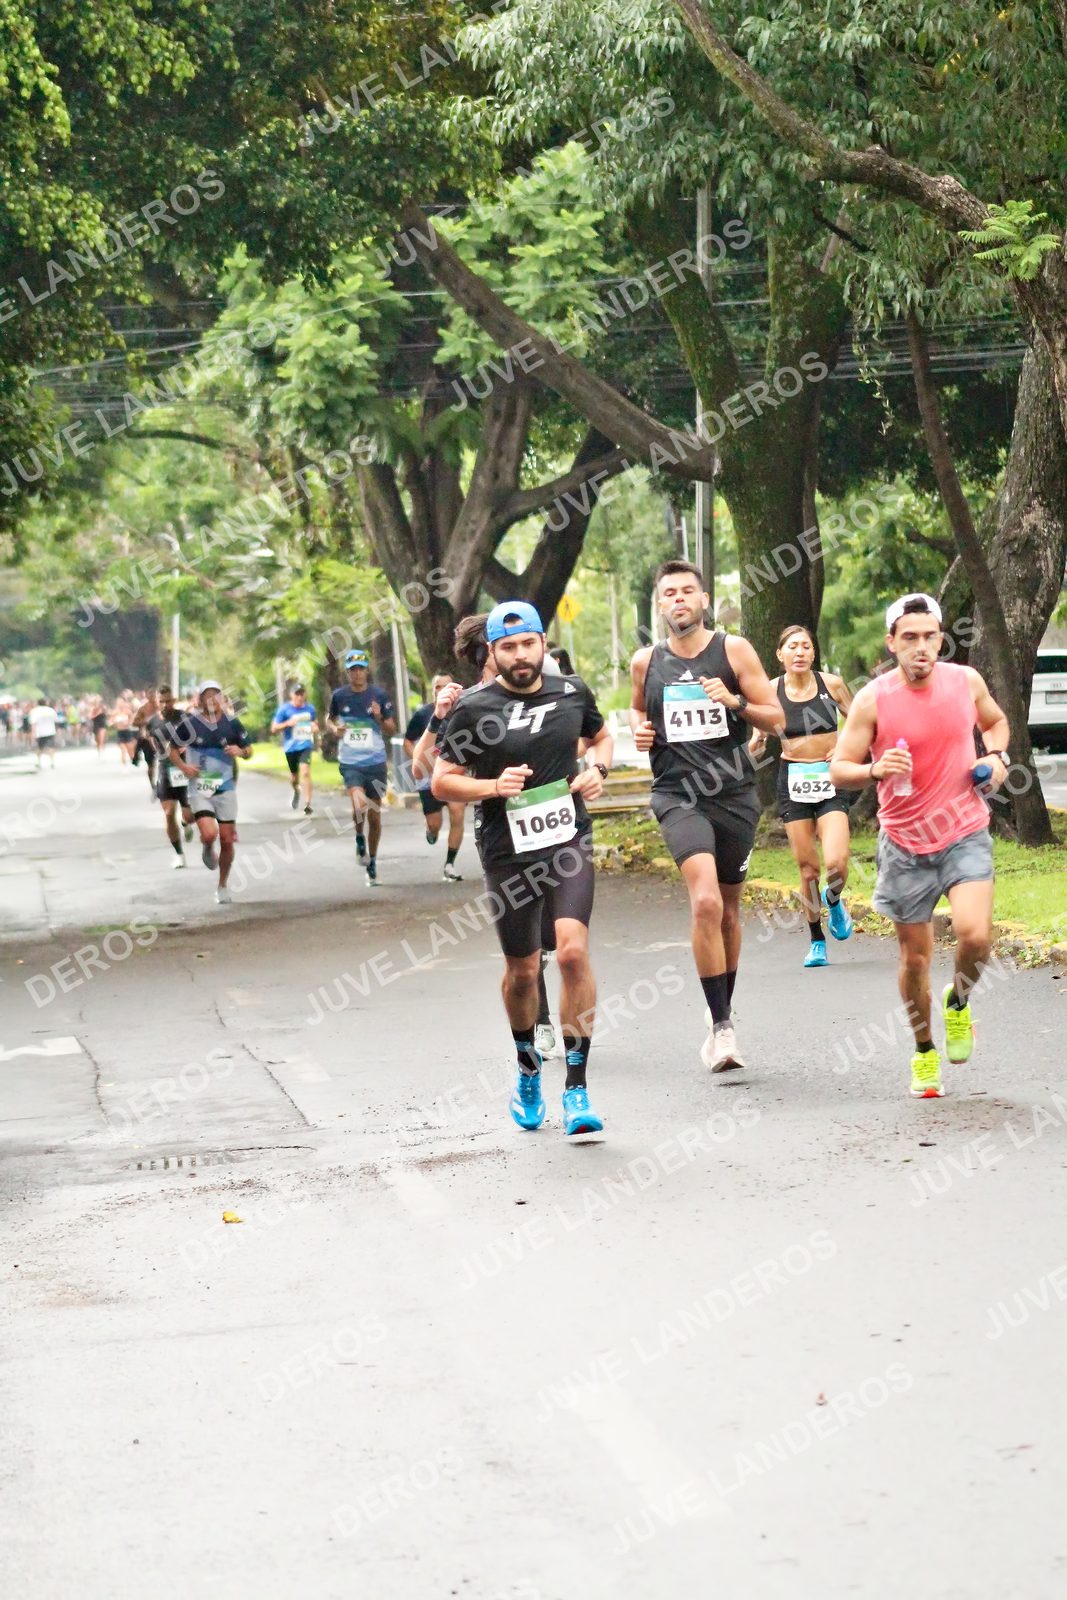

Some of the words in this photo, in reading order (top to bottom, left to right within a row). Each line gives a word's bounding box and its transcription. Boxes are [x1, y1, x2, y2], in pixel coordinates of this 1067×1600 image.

[507, 701, 559, 734] LT
[670, 708, 722, 727] 4113
[792, 780, 832, 794] 4932
[516, 807, 573, 837] 1068
